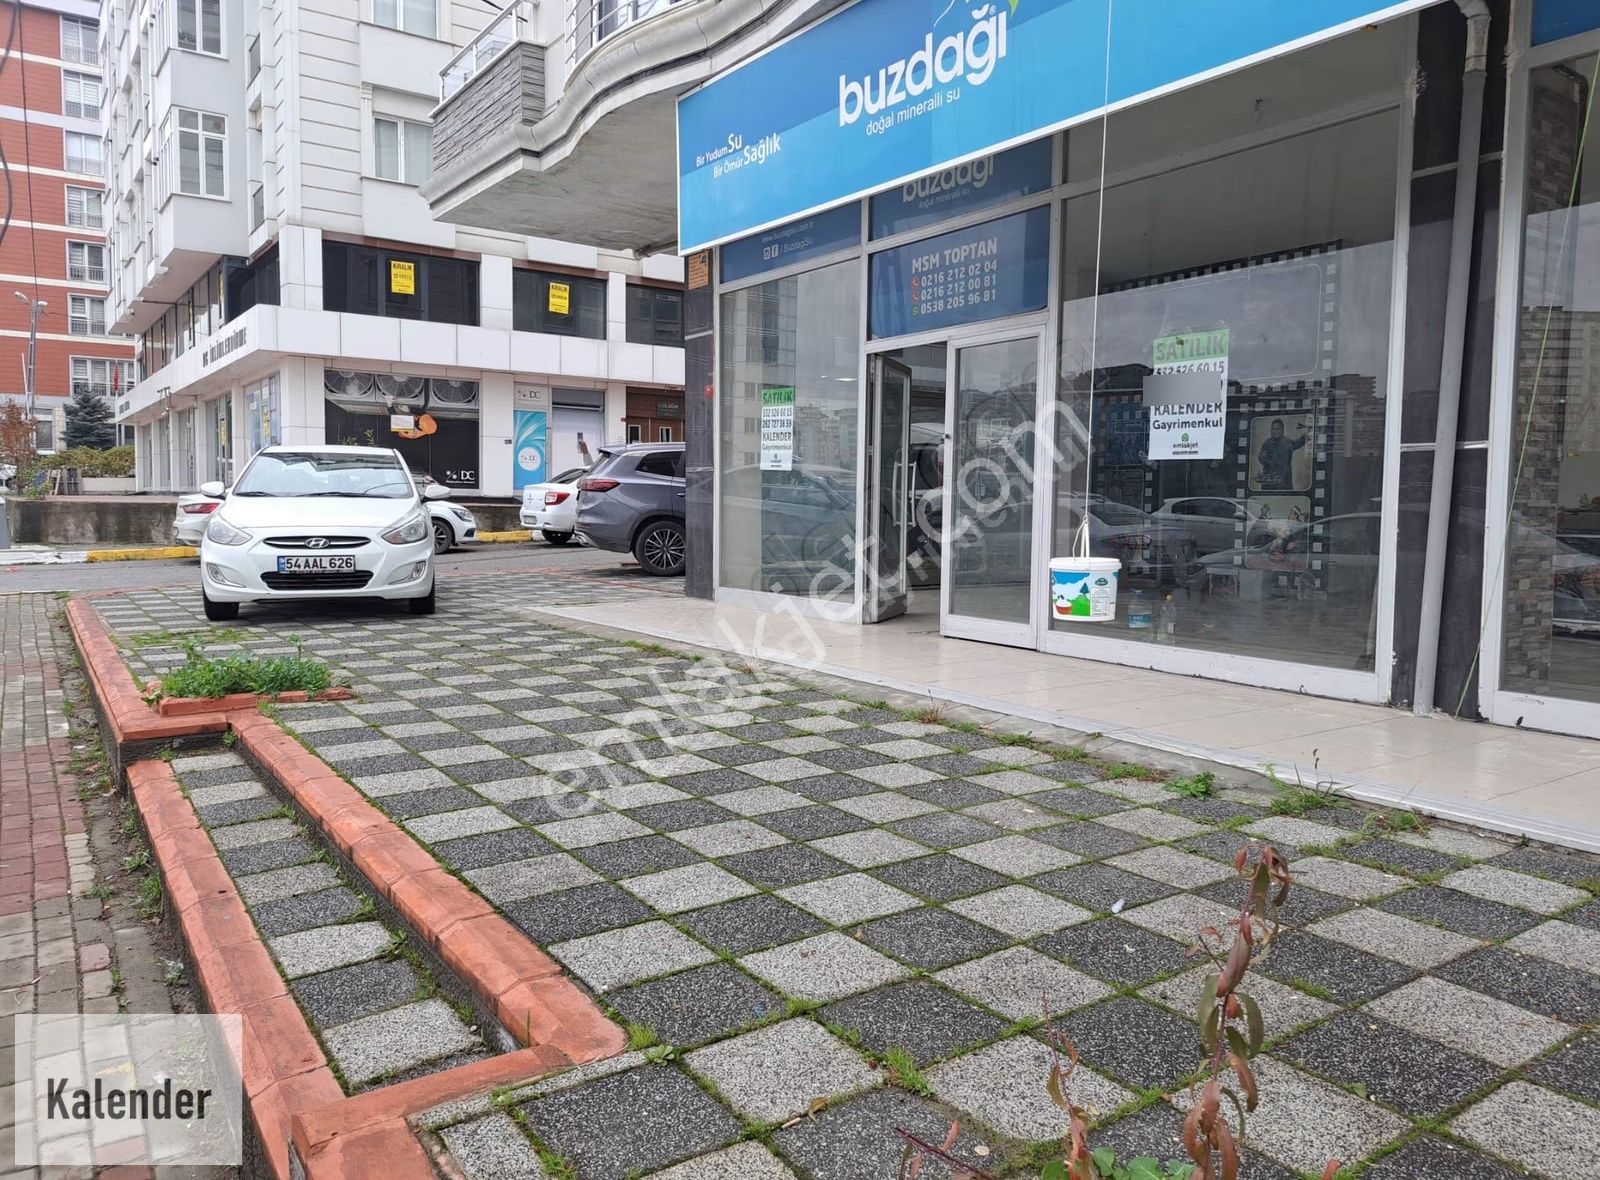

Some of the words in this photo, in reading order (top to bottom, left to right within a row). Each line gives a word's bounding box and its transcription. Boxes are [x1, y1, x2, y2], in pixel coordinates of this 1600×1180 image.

[838, 4, 1007, 127] buzdağı
[865, 115, 894, 136] doğal
[896, 93, 943, 124] mineralli
[946, 88, 960, 103] su
[695, 152, 705, 167] Bir
[706, 146, 728, 162] Yudum
[728, 133, 742, 153] Su
[713, 166, 723, 178] Bir
[723, 157, 743, 174] Ömür
[743, 132, 781, 165] Sağlık
[912, 252, 940, 274] MSM
[944, 237, 998, 265] TOPTAN
[921, 271, 945, 287] 0216
[947, 267, 965, 281] 212
[968, 263, 981, 276] 02
[984, 259, 997, 272] 04
[920, 286, 944, 301] 0216
[947, 281, 965, 295] 212
[968, 277, 981, 290] 00
[984, 274, 996, 287] 81
[920, 299, 944, 314] 0538
[947, 295, 965, 309] 205
[968, 291, 980, 305] 96
[983, 289, 996, 302] 81
[1156, 335, 1225, 360] SATILIK
[1213, 360, 1225, 374] 15
[529, 390, 541, 399] DC
[763, 390, 793, 405] SATILIK
[1153, 402, 1223, 416] KALENDER
[763, 431, 792, 442] KALENDER
[1152, 417, 1223, 432] Gayrimenkul
[460, 470, 475, 480] DC
[286, 557, 302, 570] 54
[303, 557, 327, 570] AAL
[328, 557, 354, 569] 626
